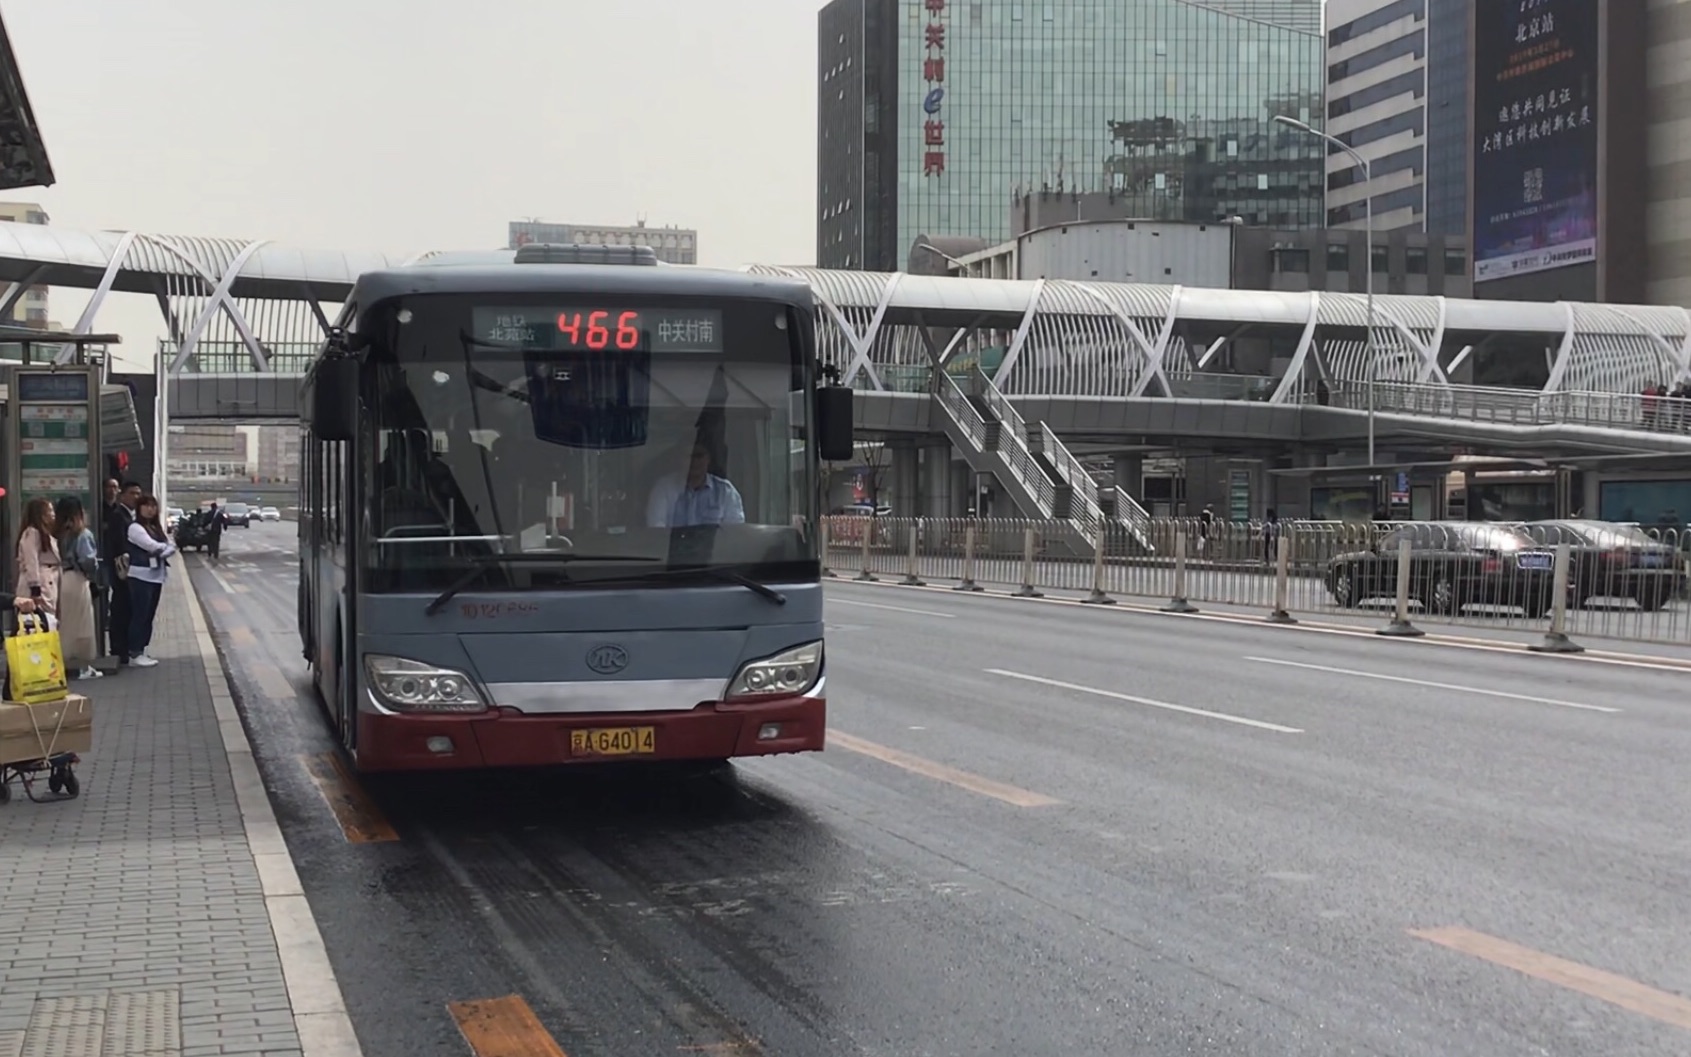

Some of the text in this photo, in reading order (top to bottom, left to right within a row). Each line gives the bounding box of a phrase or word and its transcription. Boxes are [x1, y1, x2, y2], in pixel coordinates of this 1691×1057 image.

[1515, 12, 1554, 42] 北京站
[558, 311, 639, 349] 466
[658, 319, 714, 343] 中关村南
